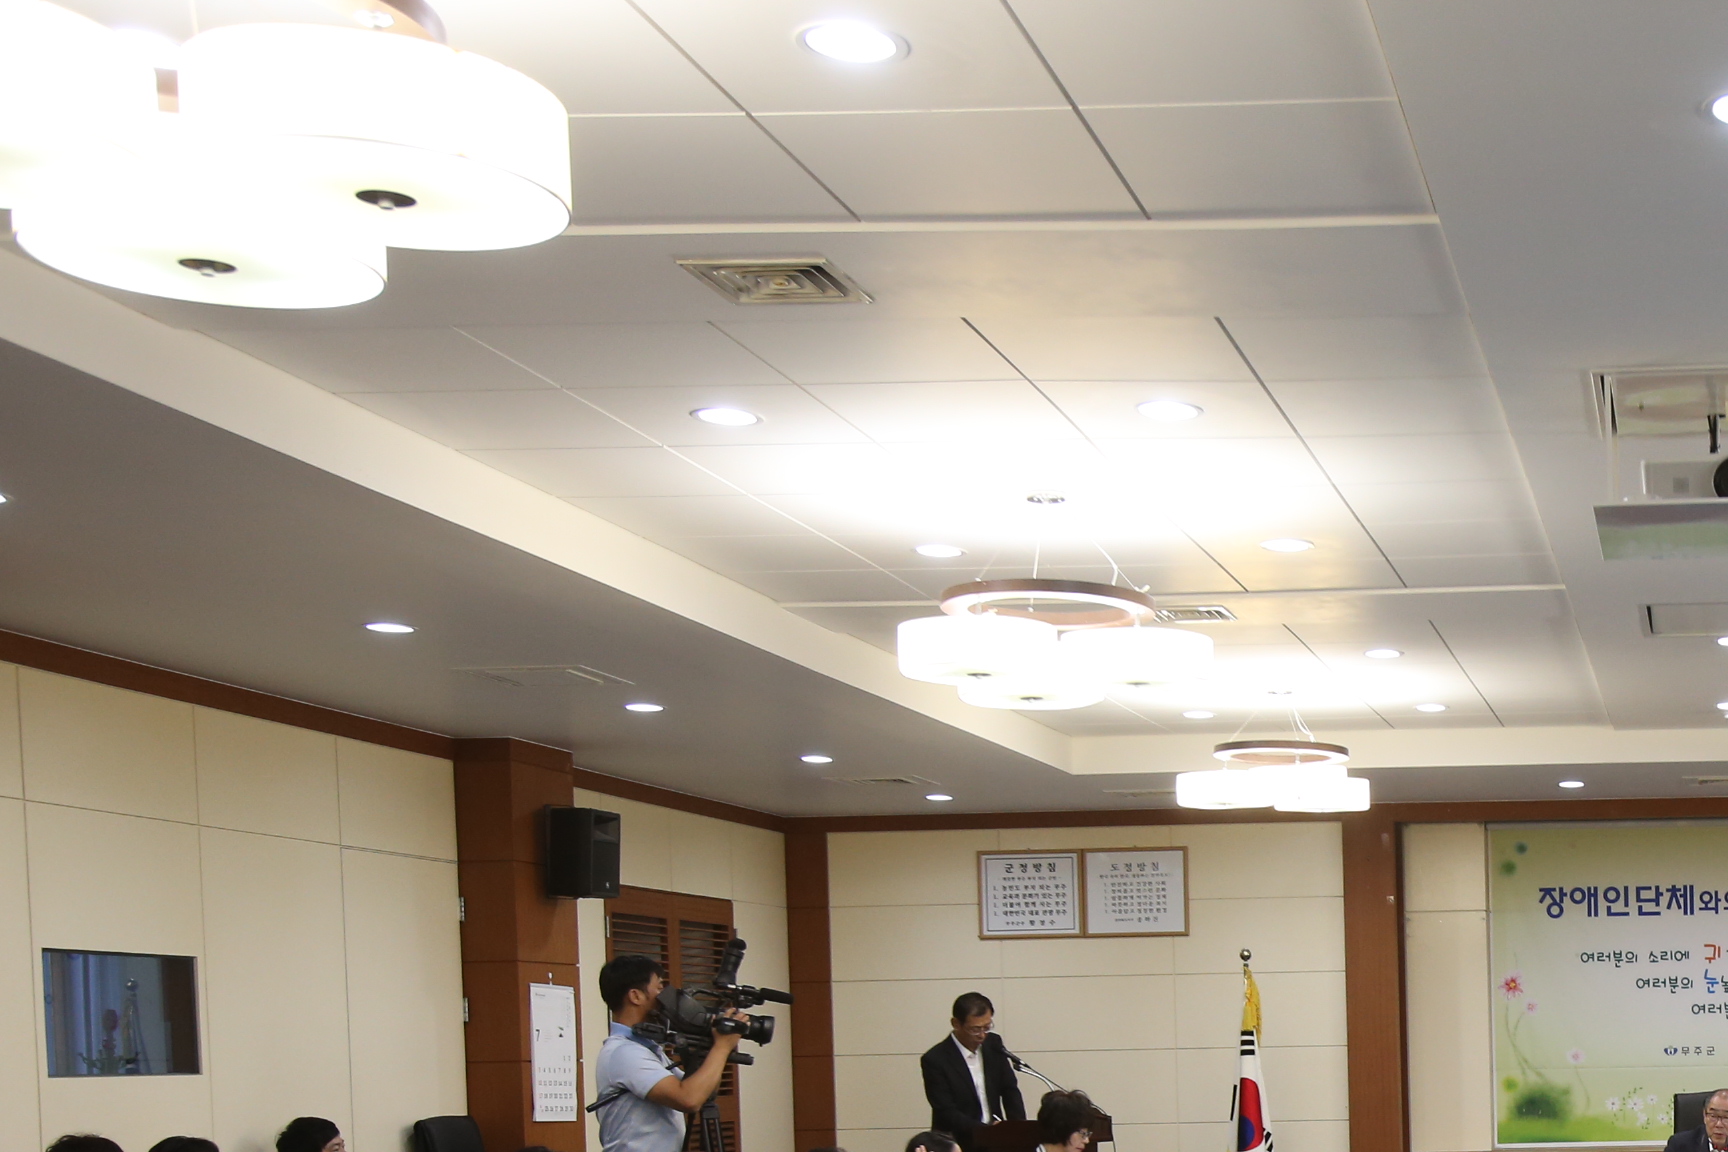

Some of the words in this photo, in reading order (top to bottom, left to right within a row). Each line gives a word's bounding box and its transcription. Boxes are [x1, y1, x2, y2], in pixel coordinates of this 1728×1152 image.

[1580, 949, 1638, 968] 여러분의
[1648, 950, 1690, 964] 소리에
[1703, 943, 1721, 964] 귀
[1636, 975, 1694, 995] 여러분의
[1681, 1046, 1715, 1056] 무주군
